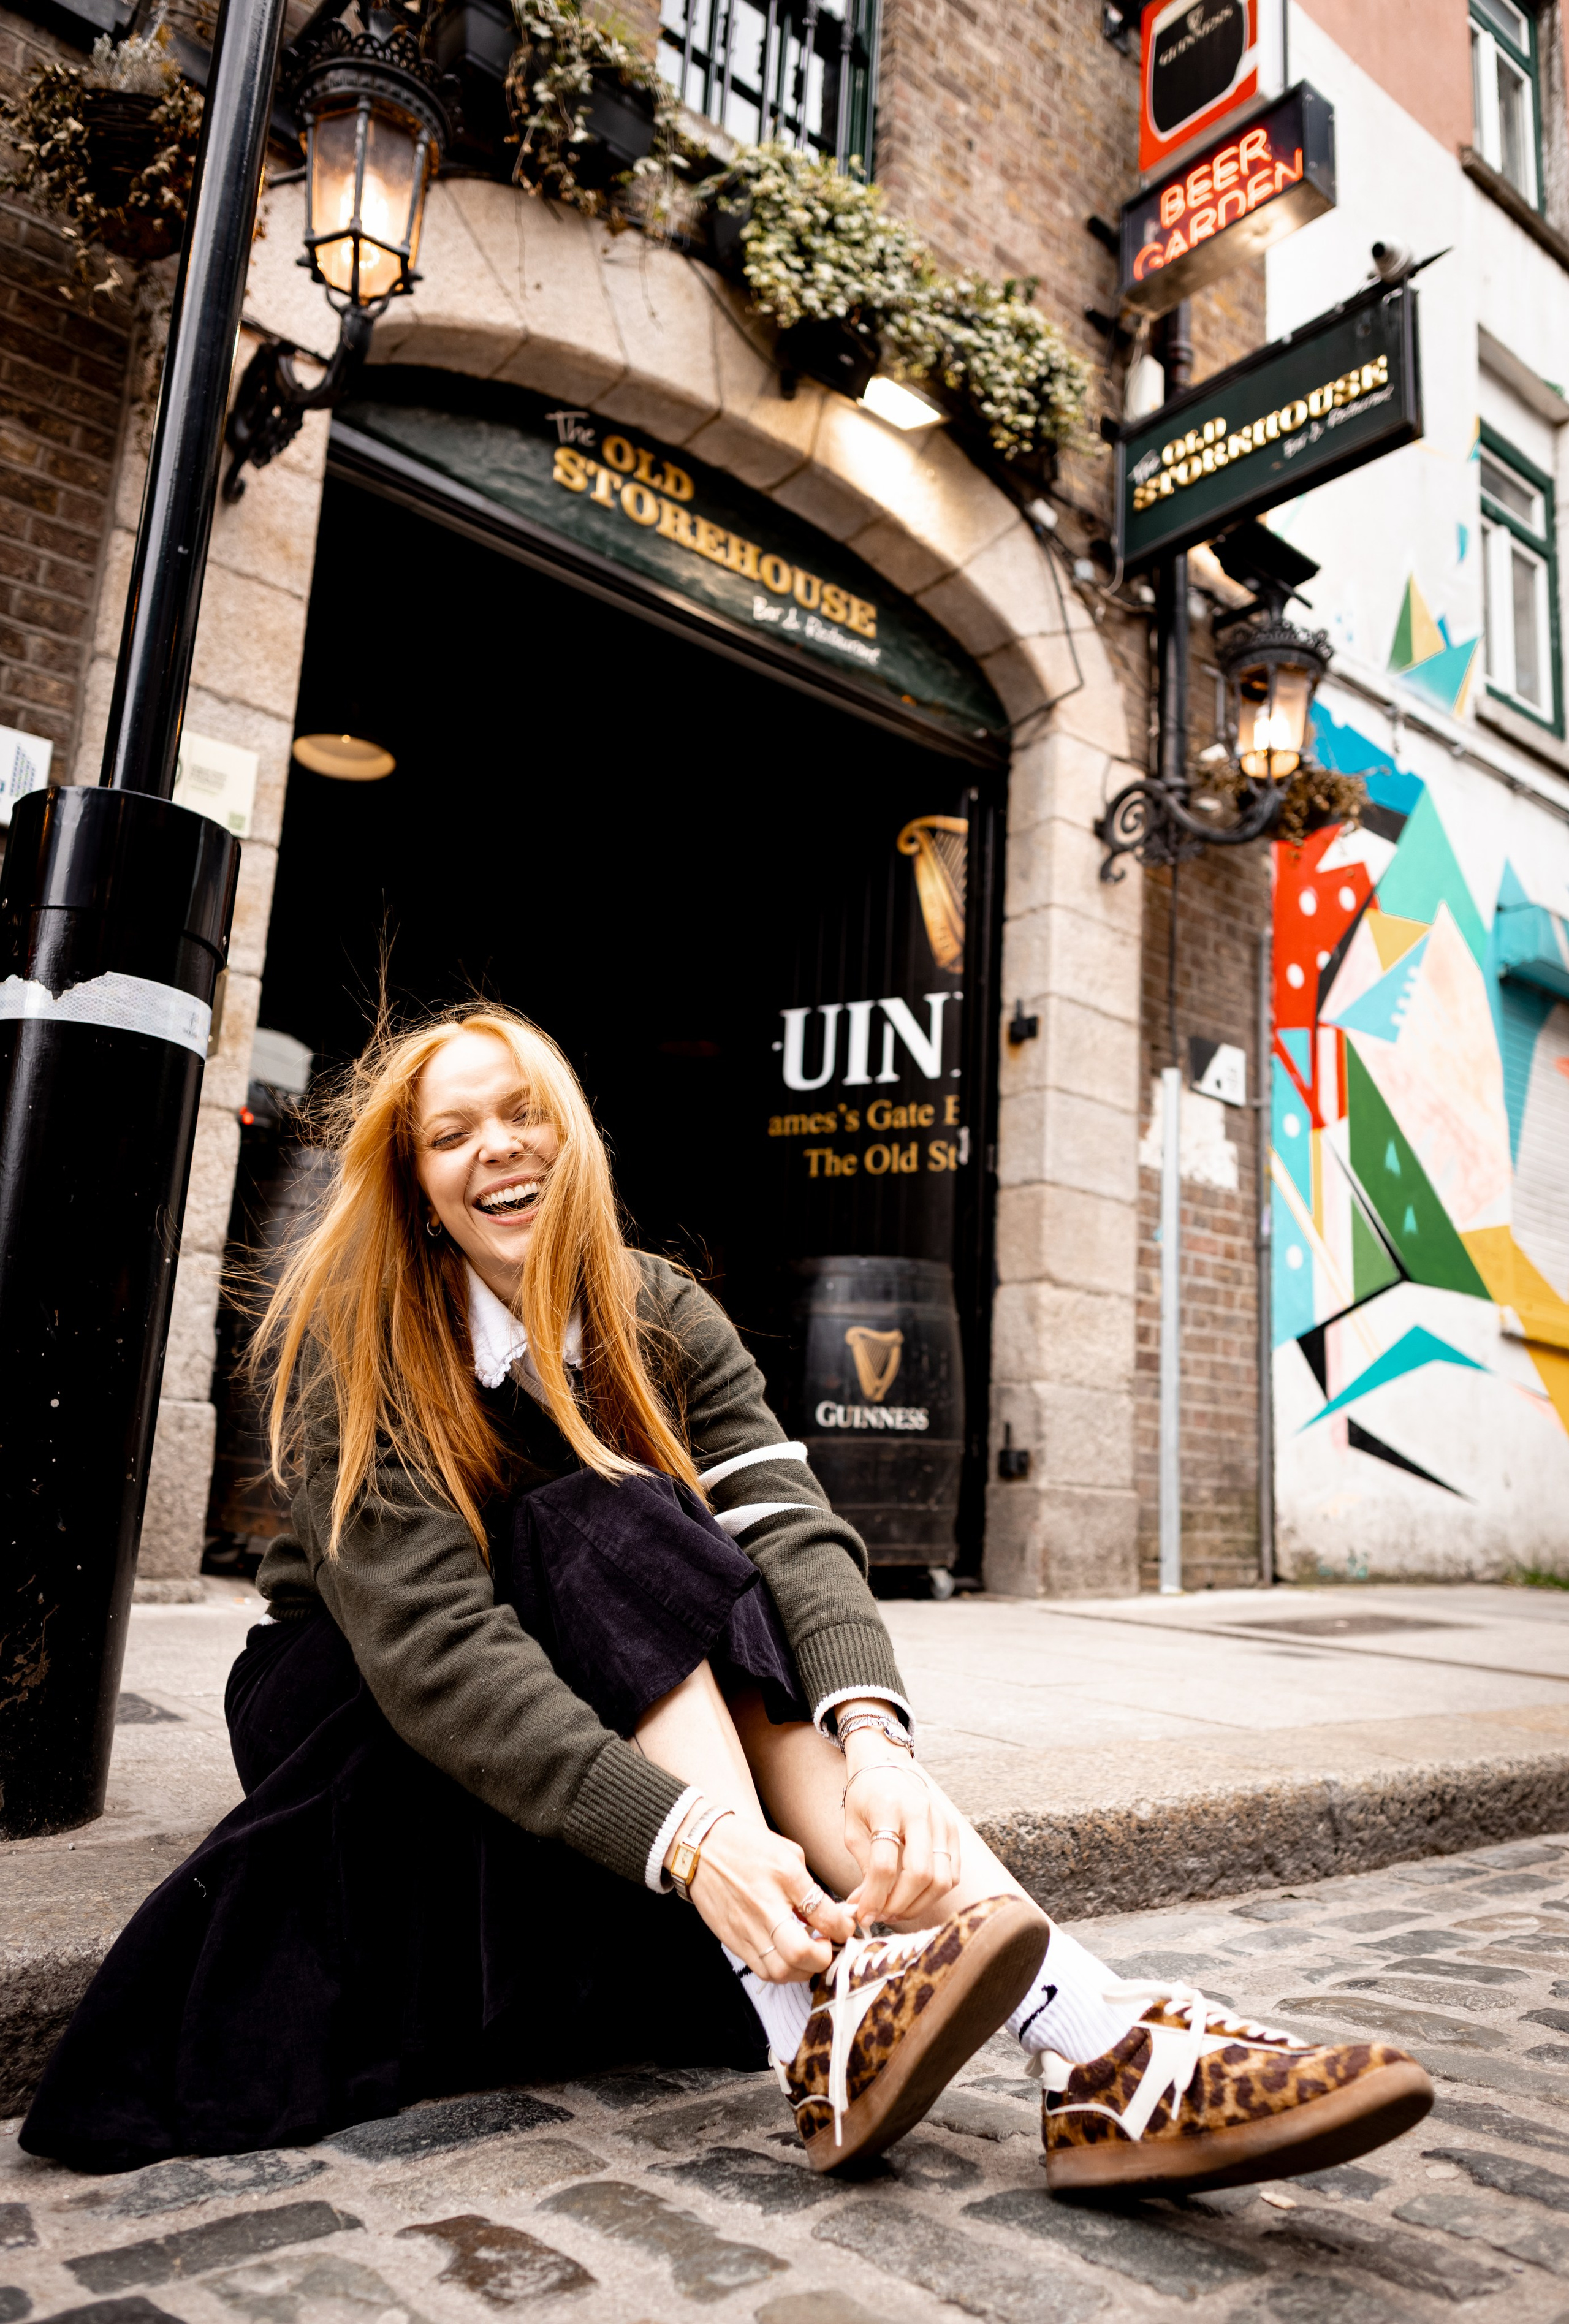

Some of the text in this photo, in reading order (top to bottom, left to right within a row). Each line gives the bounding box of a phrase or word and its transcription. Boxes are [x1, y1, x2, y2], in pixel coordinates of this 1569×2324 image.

[1133, 147, 1303, 281] GARDEN
[1160, 127, 1272, 229] BEER
[545, 411, 695, 502] The OLD
[1133, 354, 1388, 511] STOREHOUSE
[1162, 417, 1226, 466] OLD
[553, 446, 877, 639] STOREHOUSE
[753, 595, 785, 621] Bar
[781, 607, 802, 631] &
[771, 990, 964, 1091] UIN
[768, 1103, 860, 1137] ames's
[866, 1099, 935, 1131] Gate
[803, 1147, 858, 1178] The
[864, 1141, 919, 1175] Old
[815, 1400, 930, 1431] GUINNESS
